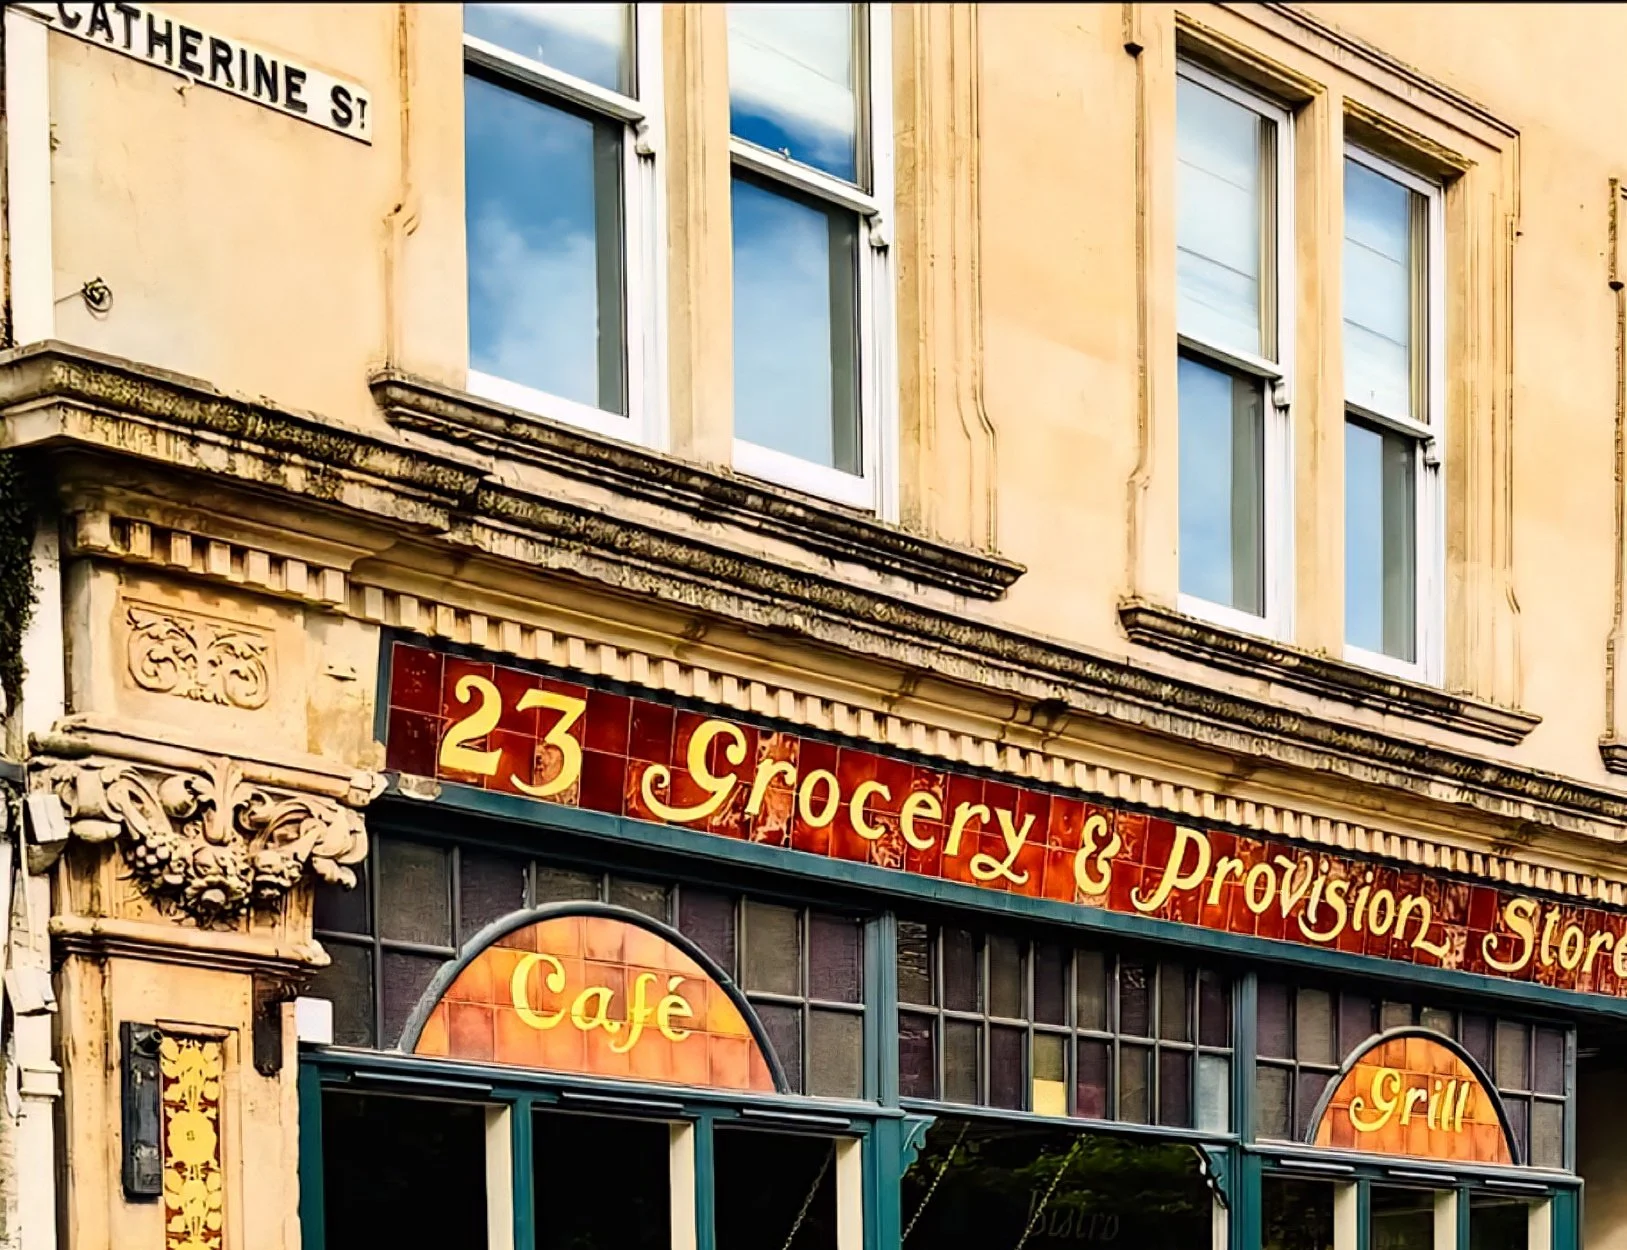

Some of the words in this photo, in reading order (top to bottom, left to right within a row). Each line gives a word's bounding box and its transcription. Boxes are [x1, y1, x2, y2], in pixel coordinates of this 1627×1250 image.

[440, 675, 587, 797] 23
[642, 720, 1036, 885] Grocery
[1074, 815, 1121, 895] &
[510, 953, 694, 1054] Café
[1349, 1067, 1470, 1133] Grill
